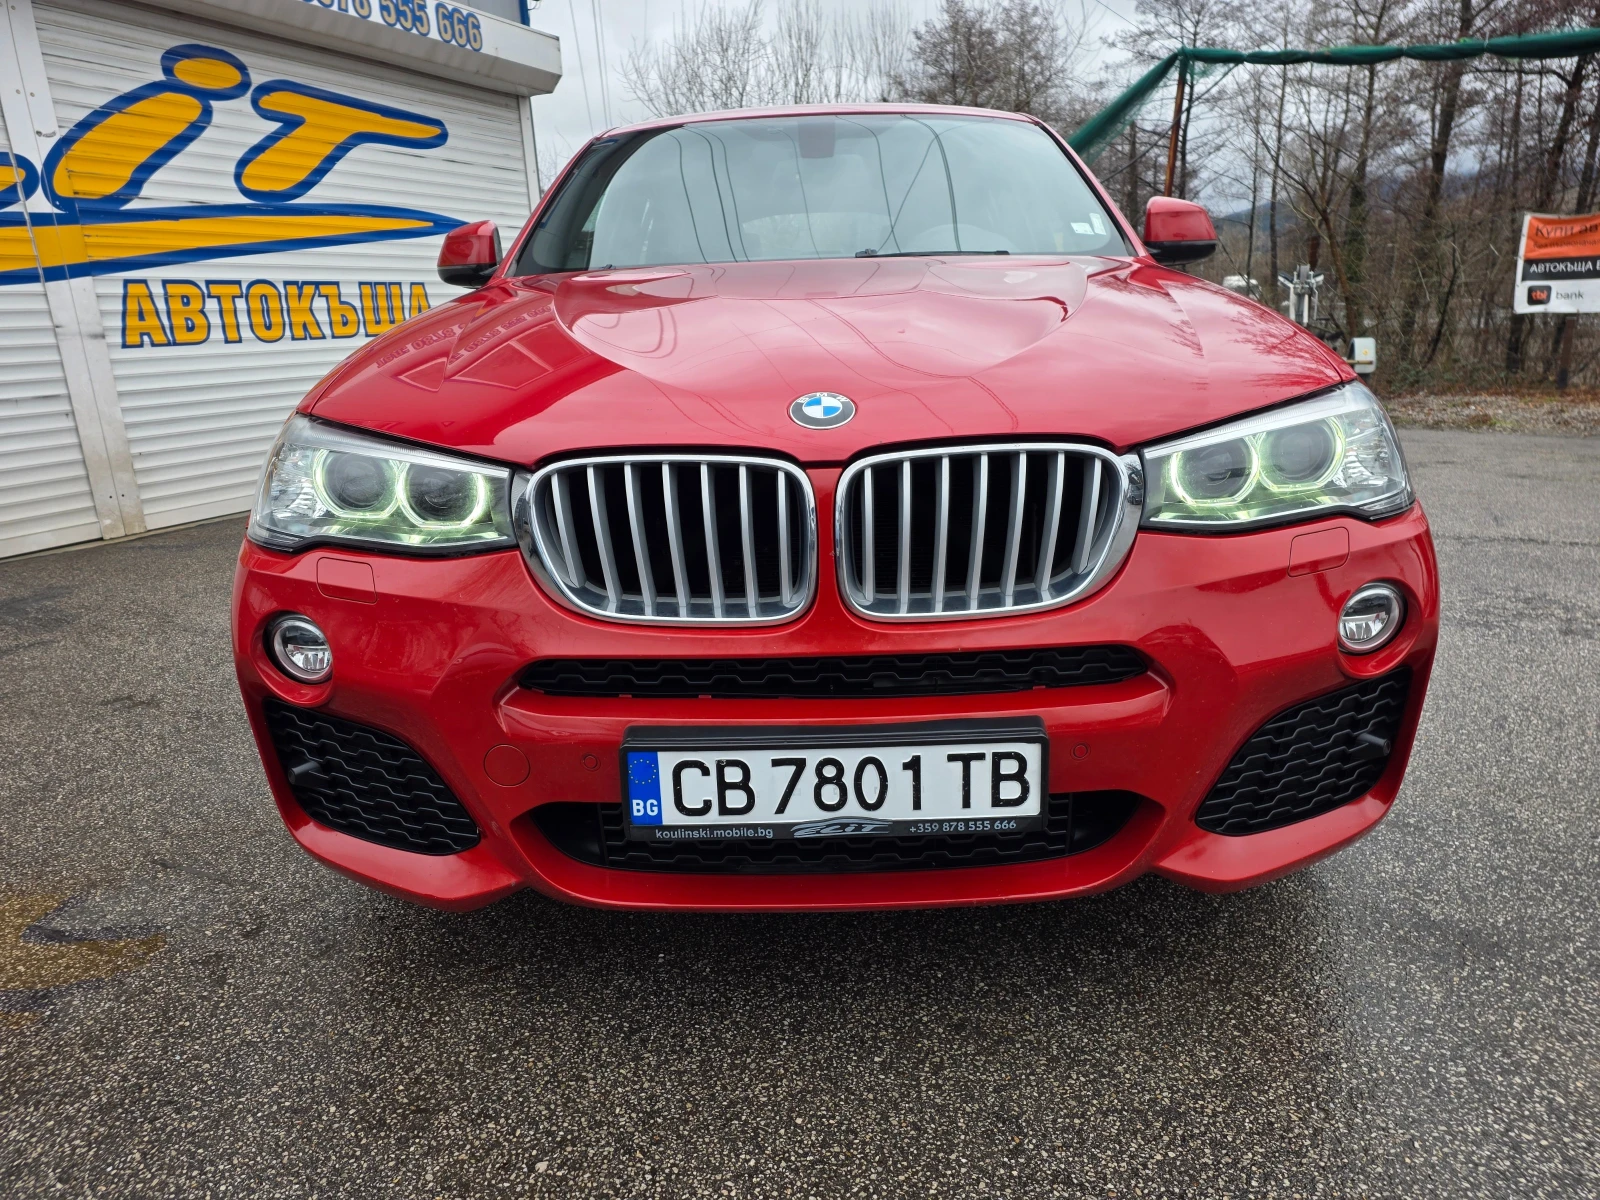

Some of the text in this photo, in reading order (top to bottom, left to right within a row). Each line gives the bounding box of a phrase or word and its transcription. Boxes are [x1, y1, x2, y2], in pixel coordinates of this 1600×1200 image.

[435, 2, 483, 52] 666
[1536, 224, 1574, 239] Купи
[1556, 290, 1584, 300] bank
[672, 751, 1031, 817] CB 7801 TB
[632, 799, 659, 817] BG
[655, 826, 774, 840] koulinski.mobile.bg
[909, 820, 1016, 833] +359 878 555 666
